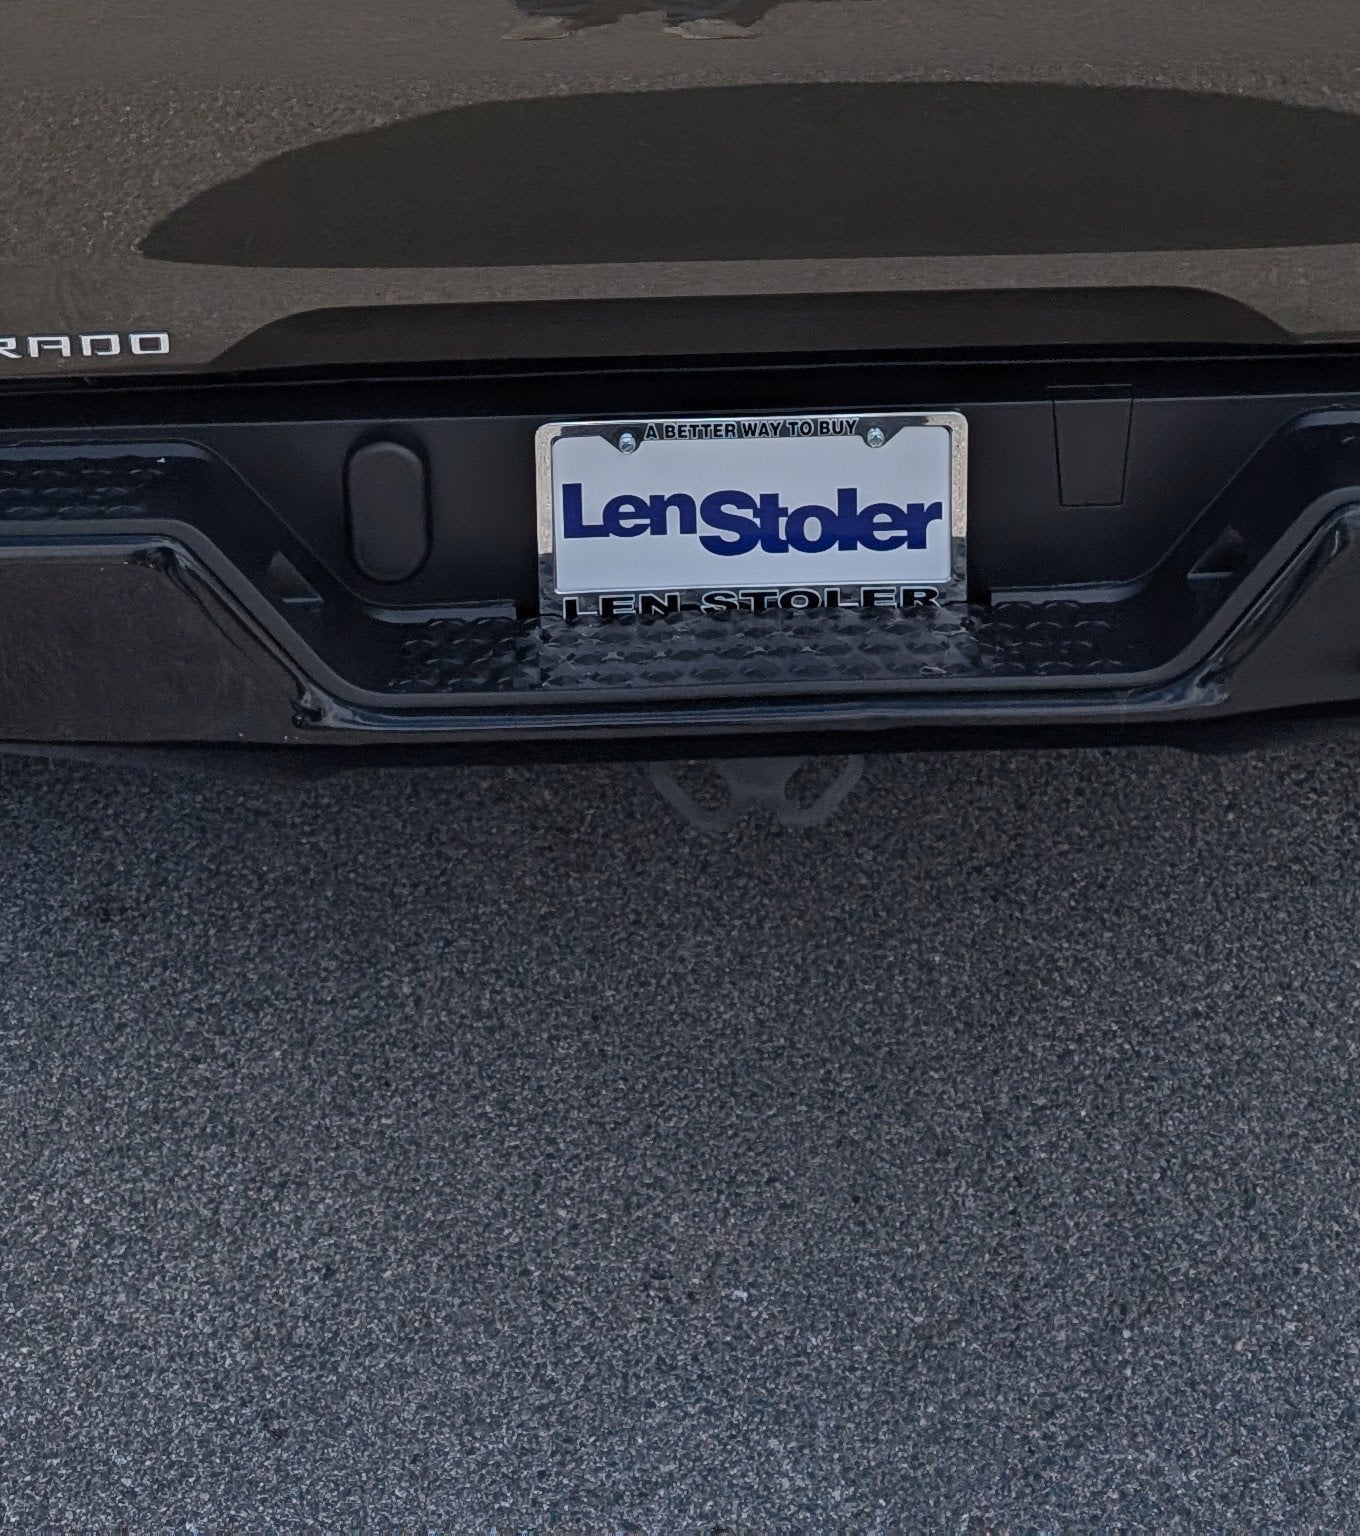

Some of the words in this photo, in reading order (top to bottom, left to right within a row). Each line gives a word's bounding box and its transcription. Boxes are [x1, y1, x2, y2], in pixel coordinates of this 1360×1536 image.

[644, 422, 660, 441] A
[663, 420, 739, 441] BETTER
[740, 419, 783, 439] WAY
[787, 418, 814, 438] TO
[816, 417, 860, 438] BUY
[562, 592, 681, 620] LEN
[700, 585, 941, 615] STOLER
